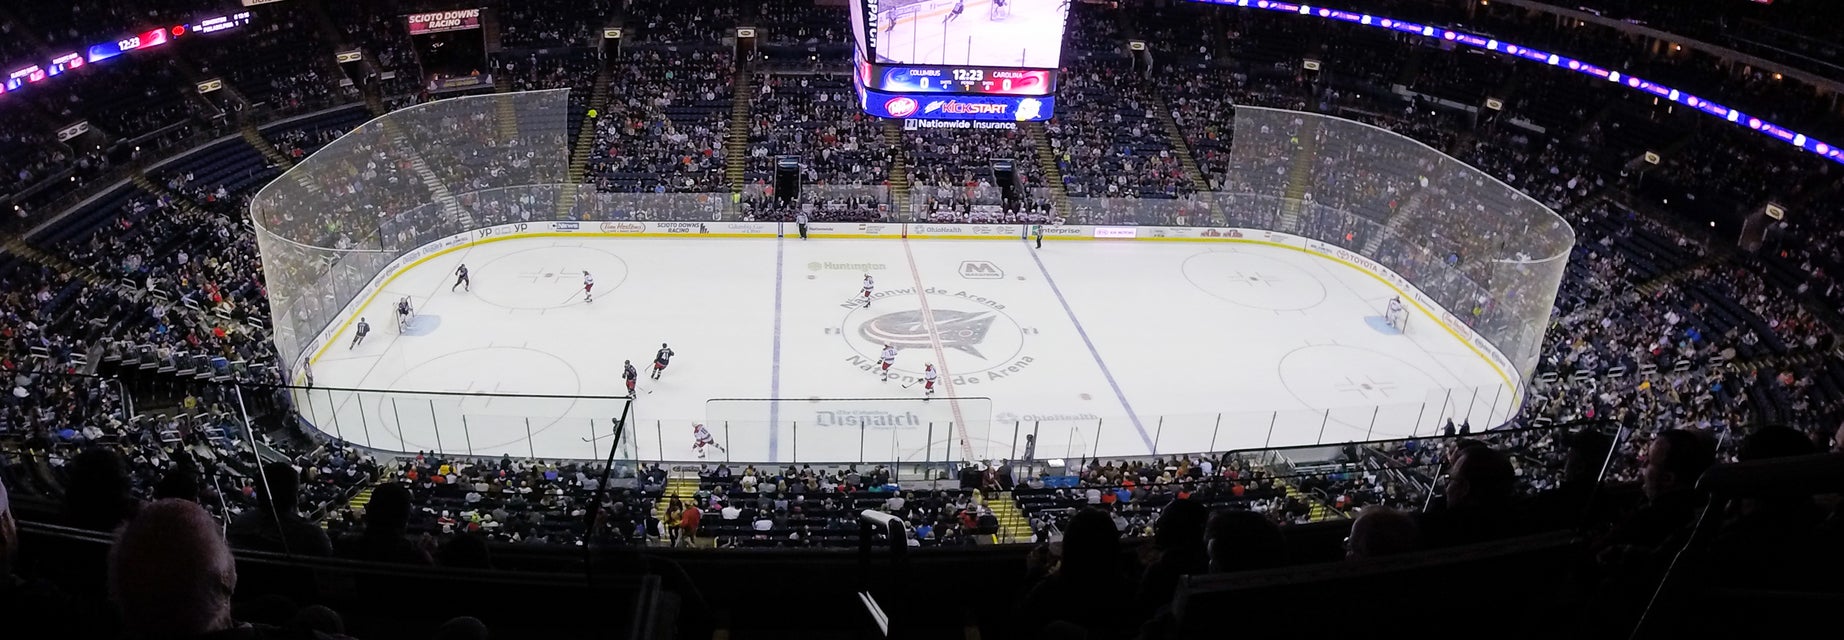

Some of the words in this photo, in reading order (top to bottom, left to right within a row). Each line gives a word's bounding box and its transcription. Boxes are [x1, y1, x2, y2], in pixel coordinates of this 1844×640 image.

[409, 13, 443, 23] SCIOTO
[444, 9, 479, 20] DOWNS
[429, 19, 460, 28] RACINO
[118, 37, 141, 51] 12:23
[910, 69, 941, 77] COLUMBUS
[953, 69, 984, 80] 12:23
[993, 71, 1023, 79] CAROLINA
[920, 77, 930, 89] 0
[1002, 79, 1012, 91] 0
[942, 100, 1007, 114] KICKSTART
[918, 119, 970, 129] Nationwide
[973, 120, 1016, 130] Insurance
[479, 228, 492, 238] yp
[514, 223, 528, 233] yp
[824, 261, 887, 272] Huntington
[1350, 255, 1378, 273] TOYOTA
[954, 290, 1006, 310] Arena
[988, 355, 1034, 382] Arena
[816, 411, 920, 427] Dispatch
